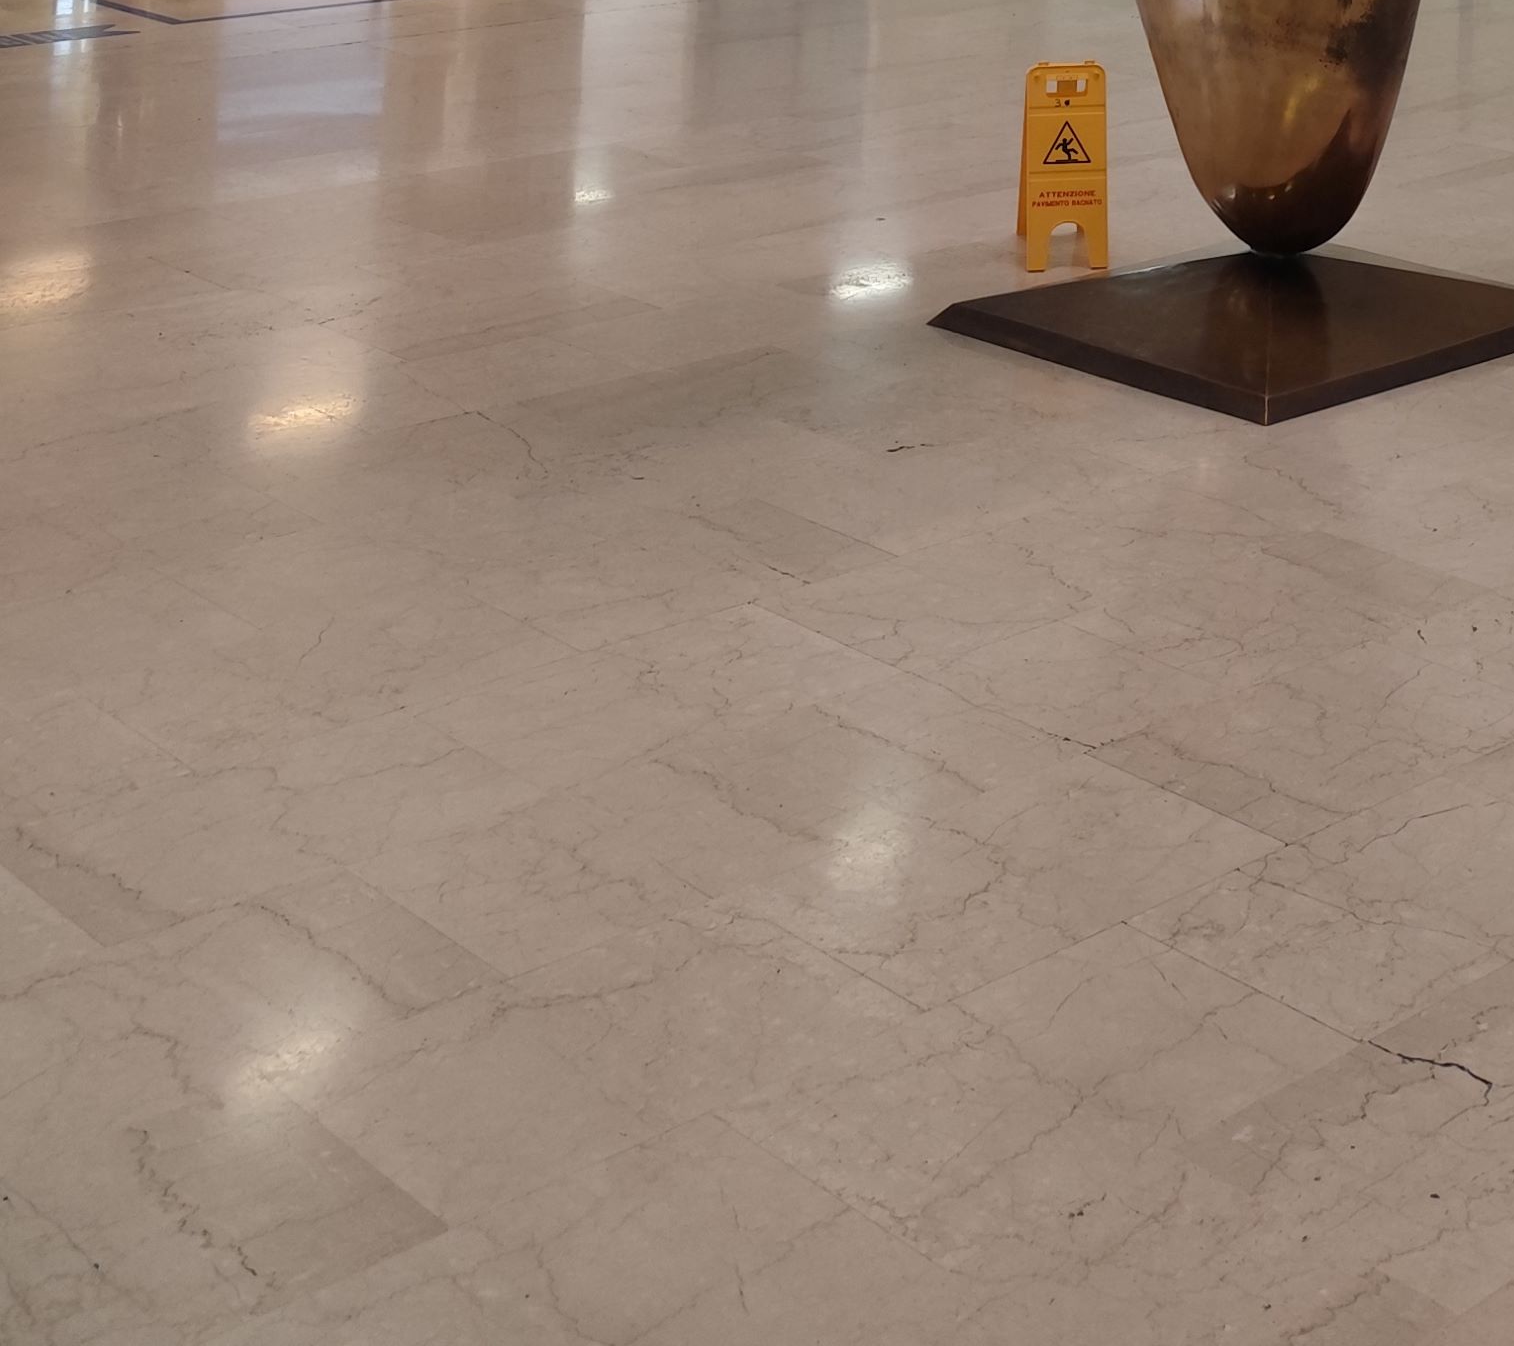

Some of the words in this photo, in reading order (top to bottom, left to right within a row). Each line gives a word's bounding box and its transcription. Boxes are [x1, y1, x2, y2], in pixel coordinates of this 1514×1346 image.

[1039, 190, 1096, 198] ATTENZIONE
[1031, 200, 1069, 208] PAVIMENTO
[1071, 199, 1102, 207] BAGNATO
